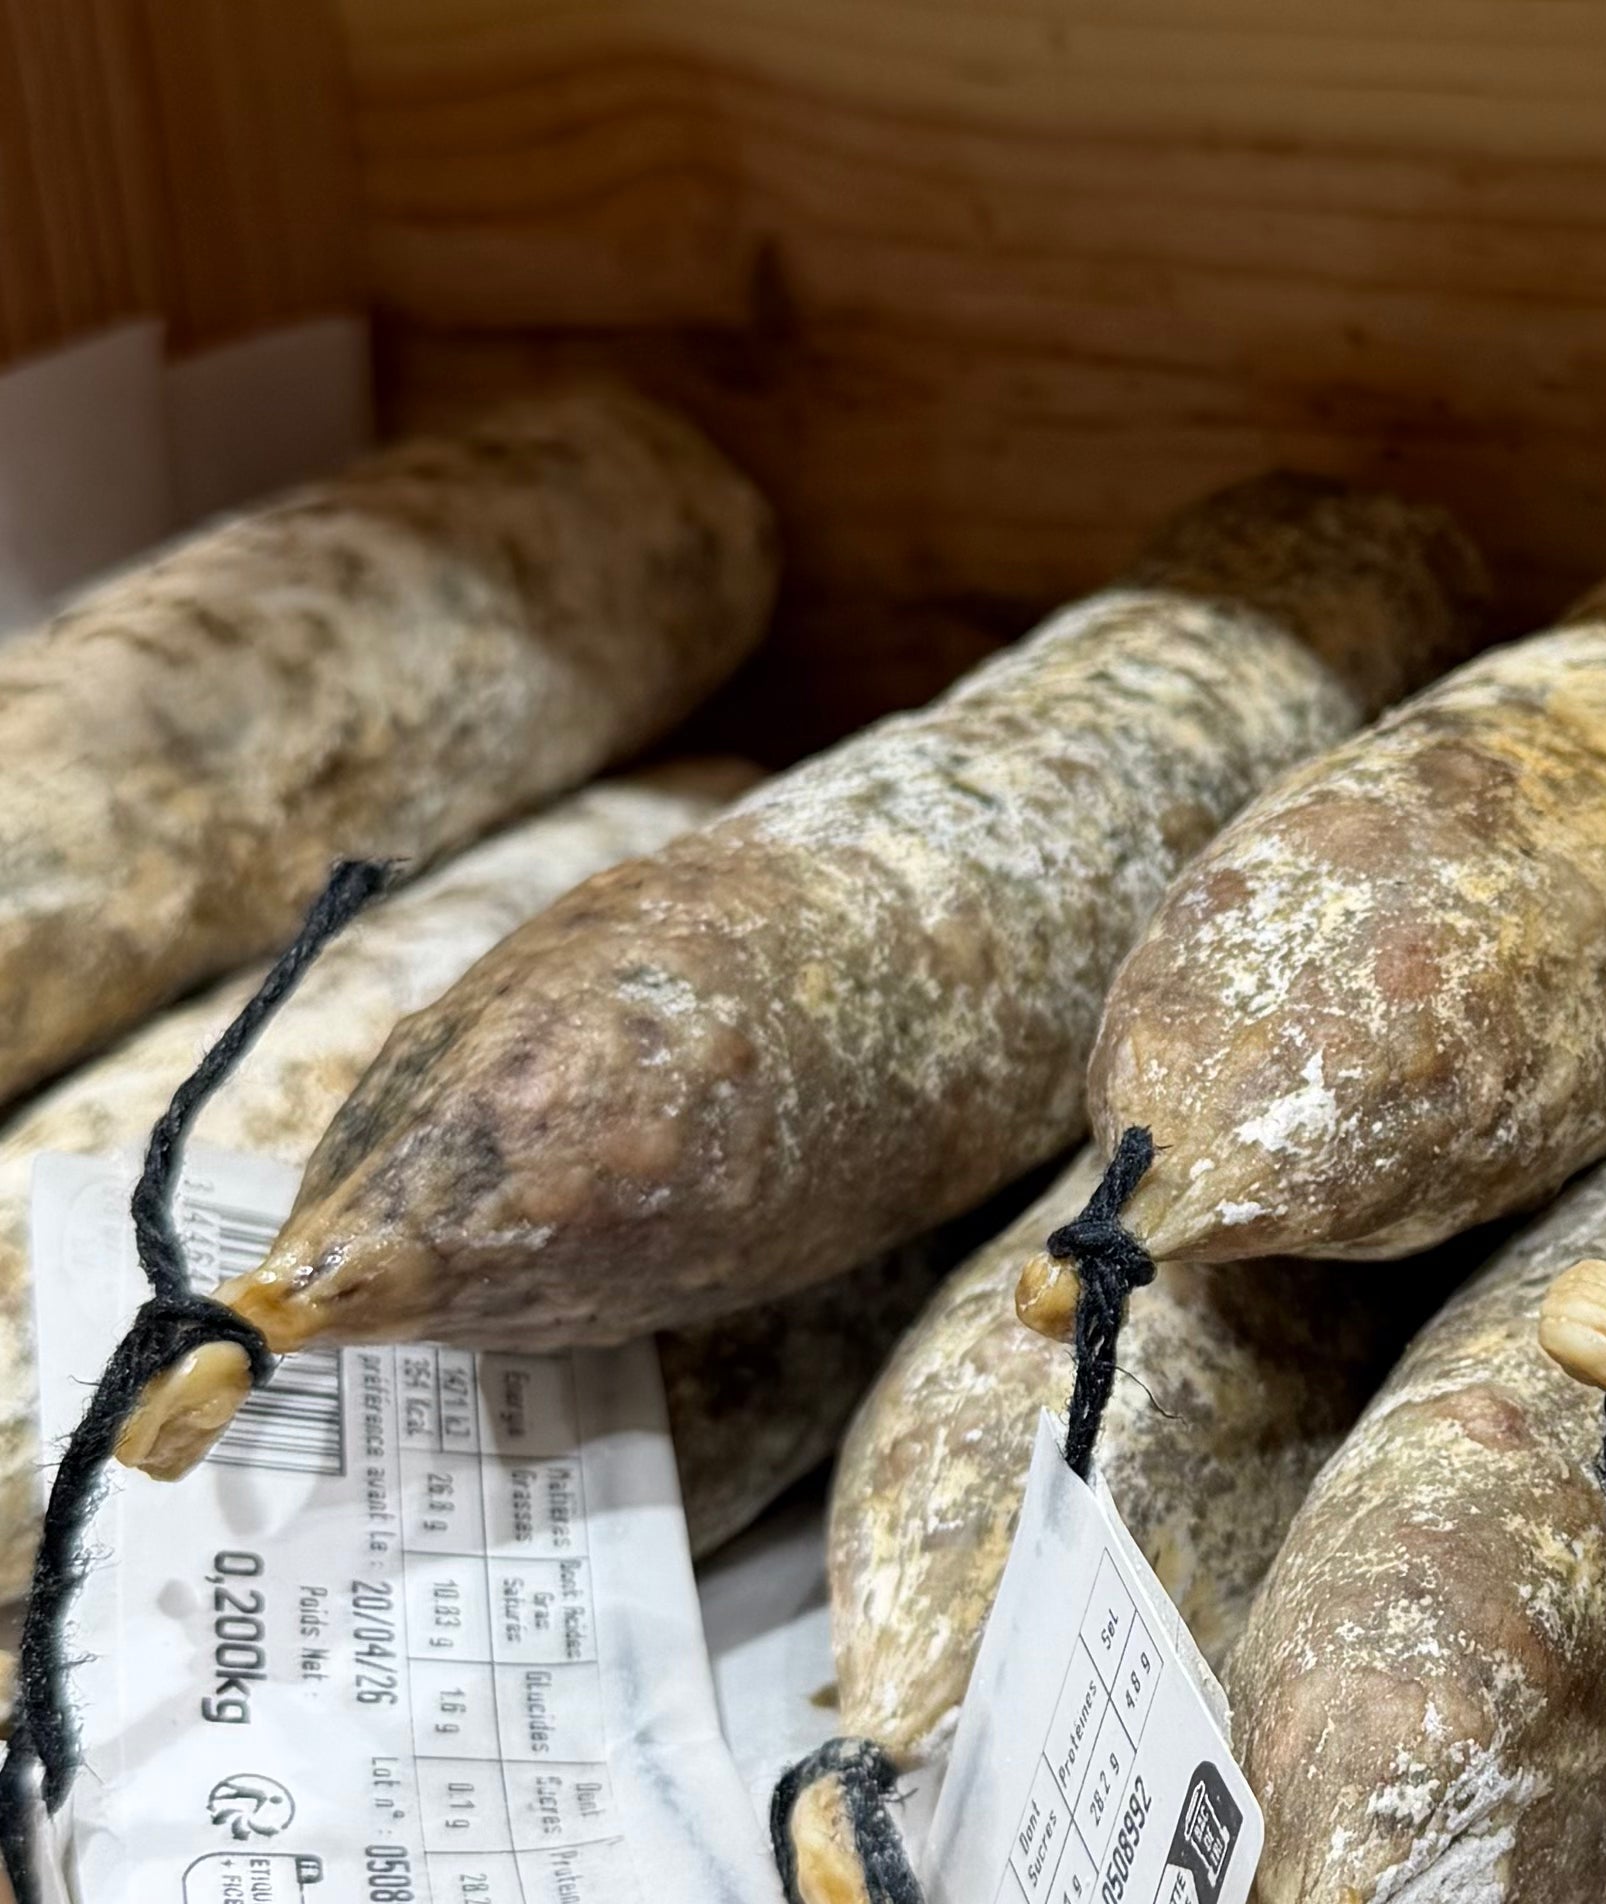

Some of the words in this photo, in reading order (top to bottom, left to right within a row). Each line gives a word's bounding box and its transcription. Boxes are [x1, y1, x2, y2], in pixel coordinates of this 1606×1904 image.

[200, 1551, 267, 1724] 0,200kg
[298, 1585, 329, 1638] Poids
[1100, 1608, 1119, 1651] Sel
[349, 1580, 398, 1705] 20/04/26
[1125, 1670, 1141, 1709] 4.8
[1053, 1679, 1097, 1790] Protéines
[1089, 1769, 1111, 1827] 28.2
[1018, 1799, 1041, 1857] Dont
[1027, 1809, 1057, 1889] Sucres
